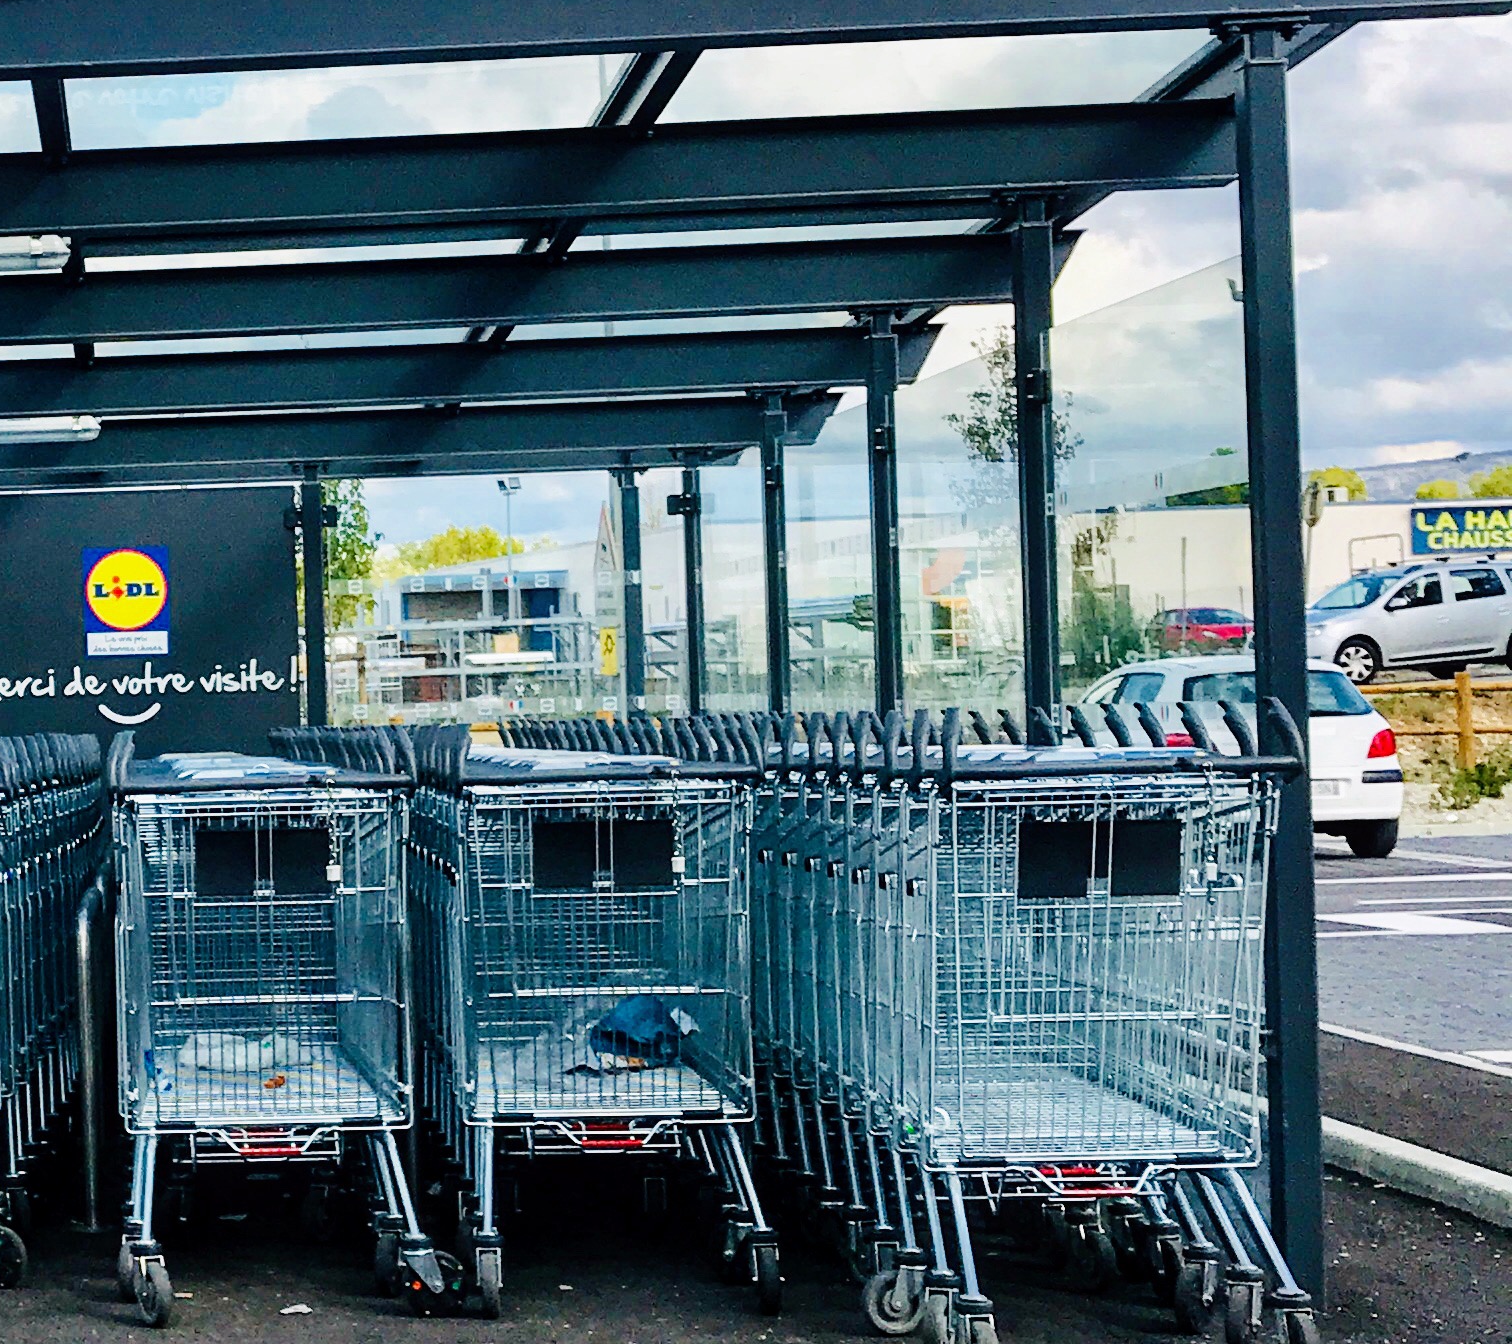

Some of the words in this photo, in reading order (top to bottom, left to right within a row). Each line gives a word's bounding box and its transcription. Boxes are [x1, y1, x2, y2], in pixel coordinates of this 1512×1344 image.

[1415, 511, 1458, 532] LA
[1464, 509, 1512, 531] HA
[63, 666, 107, 695] de
[111, 661, 195, 694] votre
